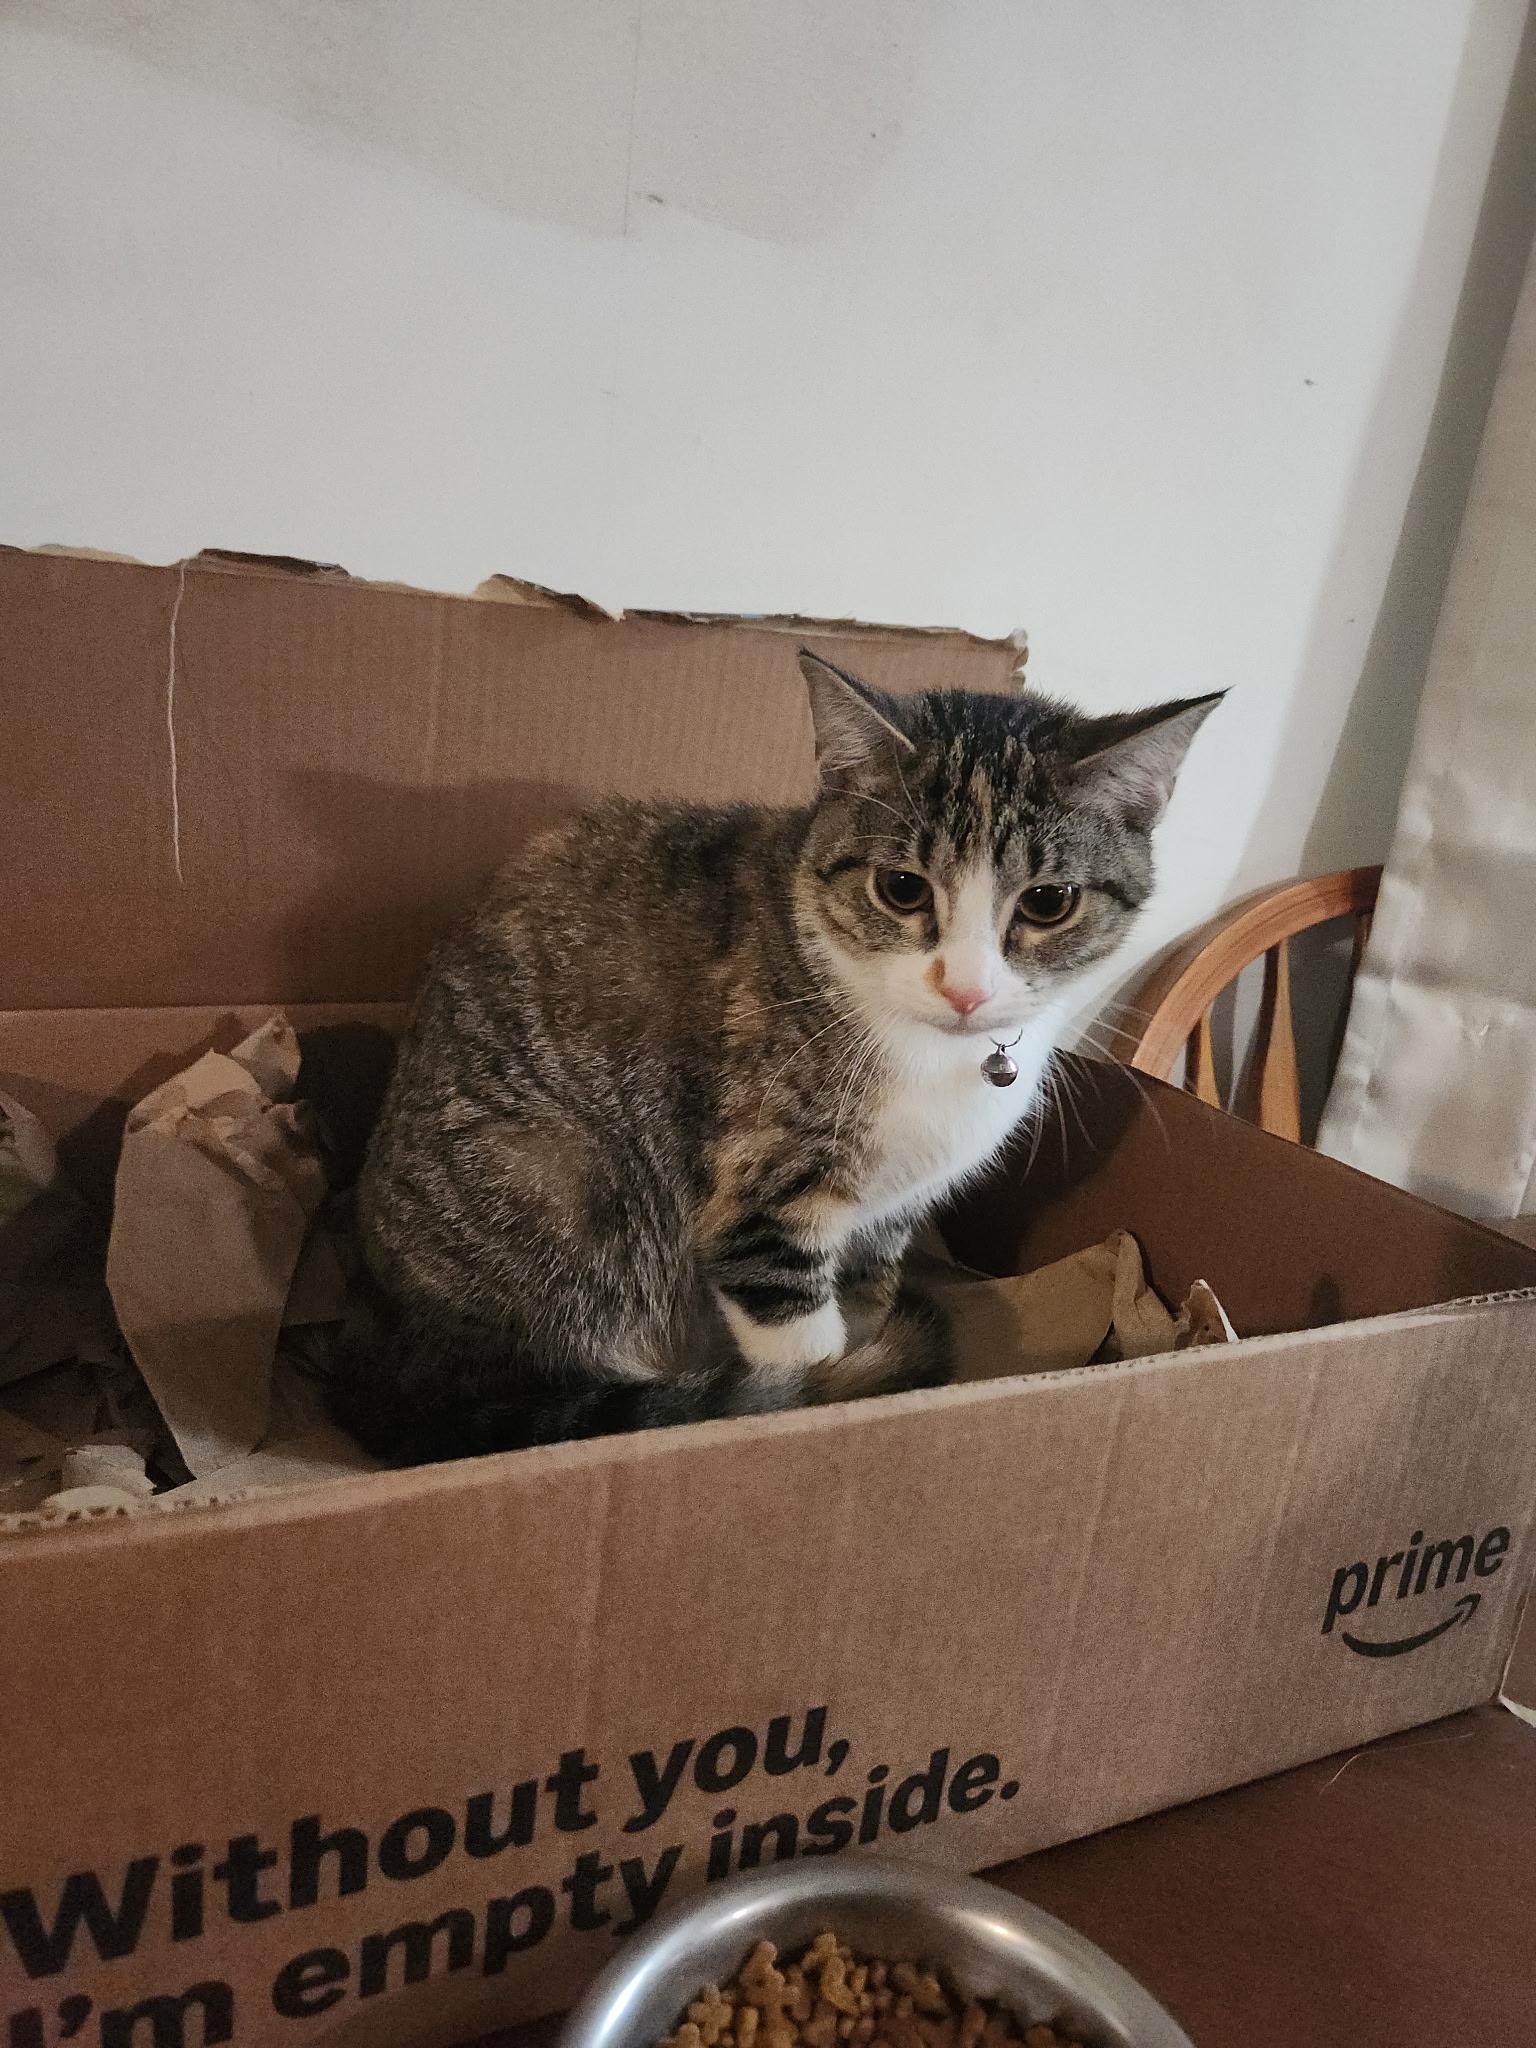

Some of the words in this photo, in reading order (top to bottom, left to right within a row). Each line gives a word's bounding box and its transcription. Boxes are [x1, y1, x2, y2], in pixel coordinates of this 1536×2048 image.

[1321, 1526, 1511, 1634] prime
[0, 1748, 600, 1979] Without
[622, 1706, 850, 1833] you,
[272, 1845, 683, 2018] empty
[706, 1748, 1021, 1882] inside.
